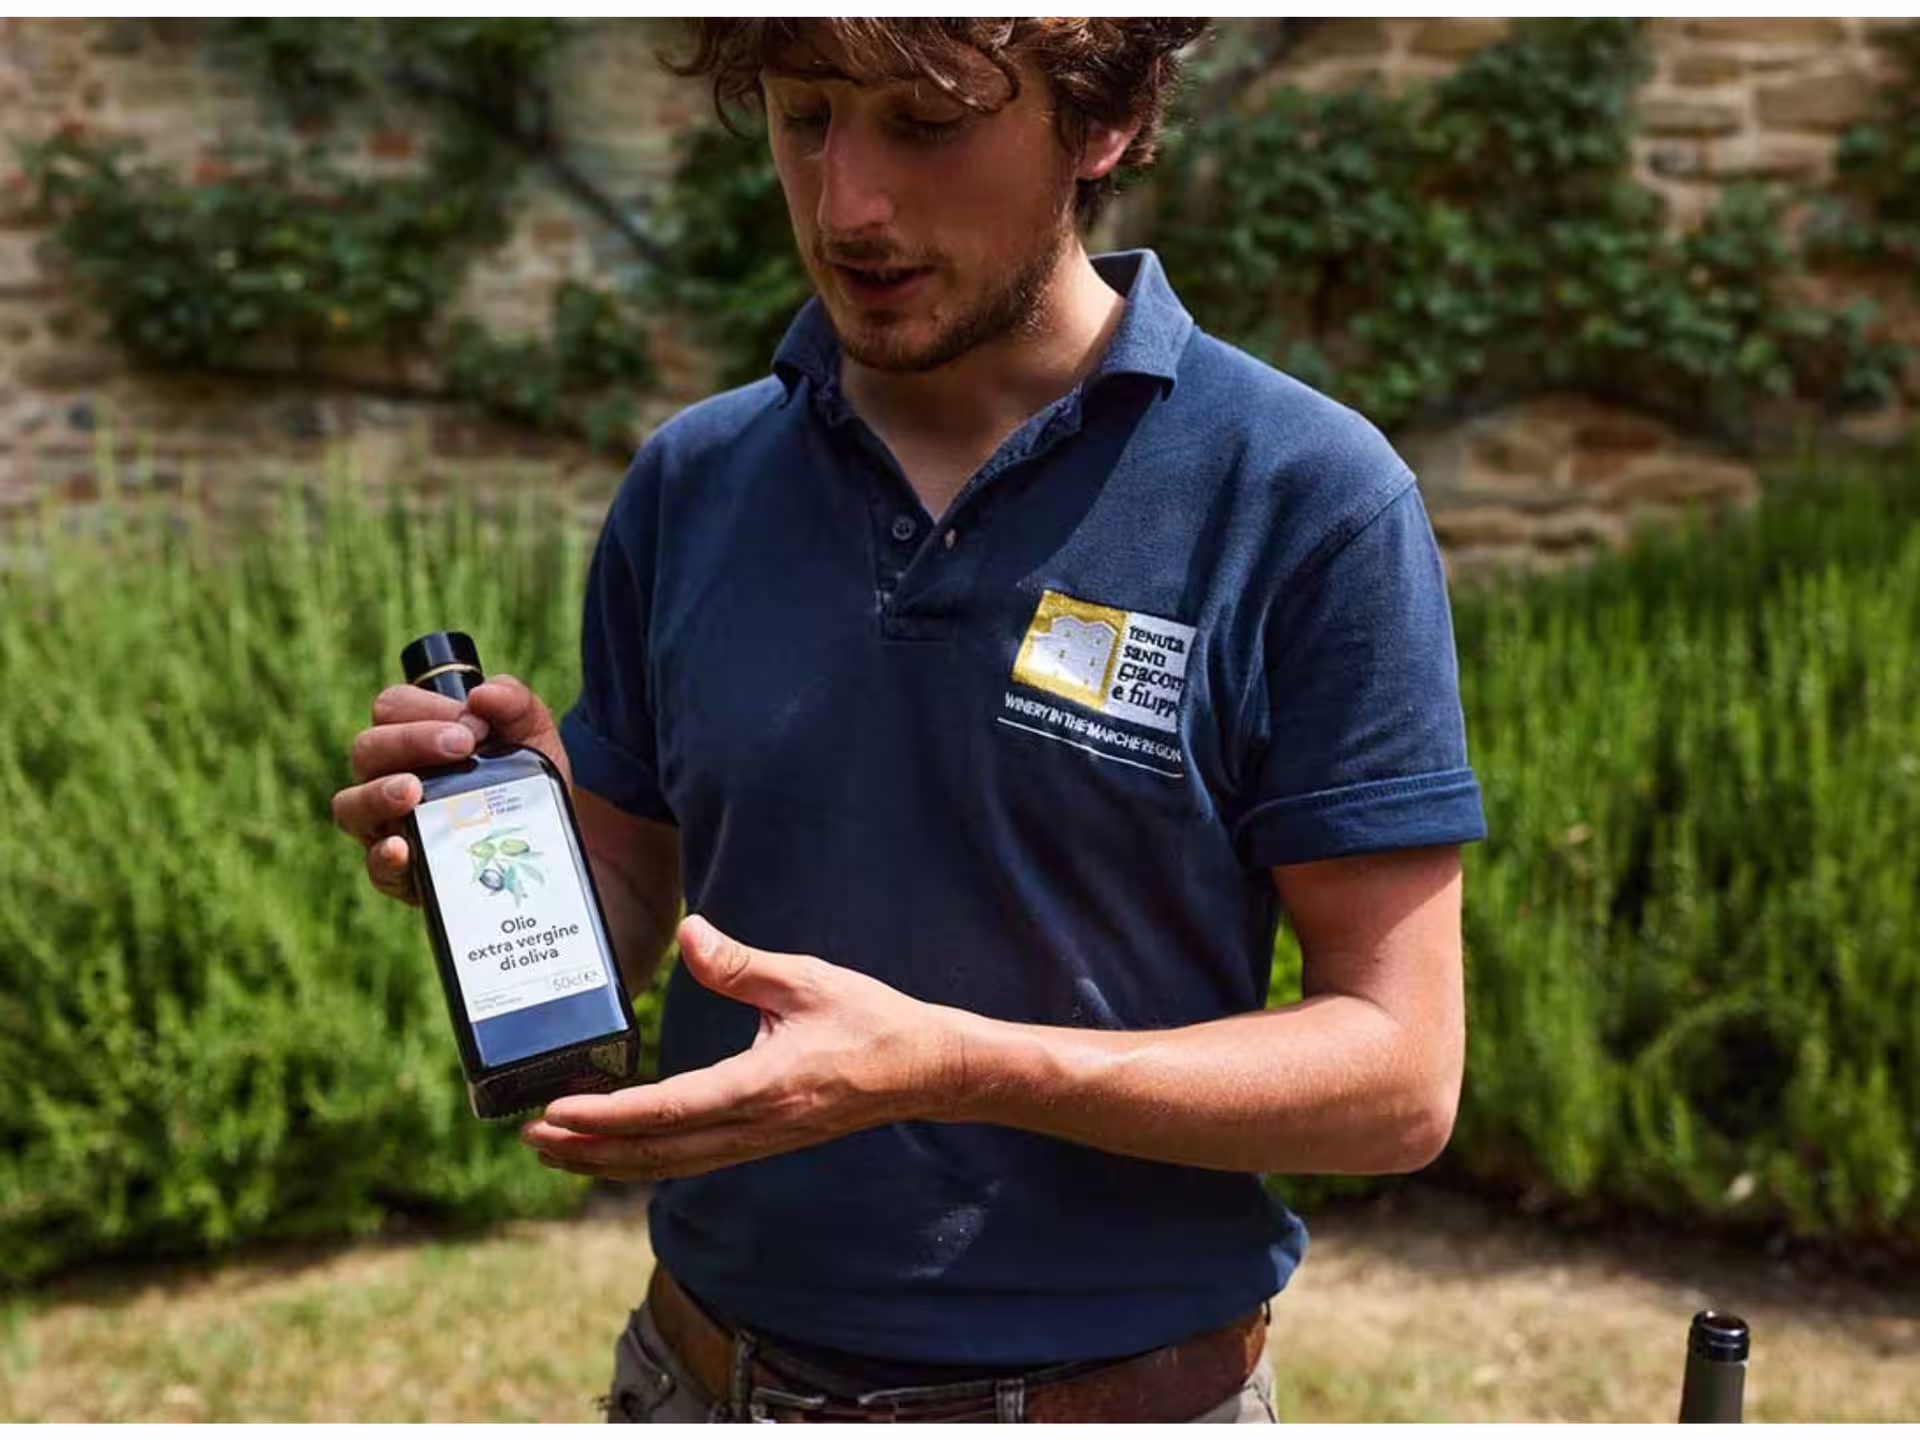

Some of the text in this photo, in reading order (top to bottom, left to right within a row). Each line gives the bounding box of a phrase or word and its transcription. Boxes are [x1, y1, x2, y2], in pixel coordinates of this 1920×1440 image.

[1111, 685, 1124, 701] e
[1005, 691, 1050, 721] WINERY
[1049, 707, 1063, 726] IN
[1062, 711, 1087, 732] THE
[1086, 723, 1142, 752] MARCHE
[501, 916, 537, 934] Olio
[467, 923, 580, 961] extra vergine
[500, 948, 559, 971] di oliva
